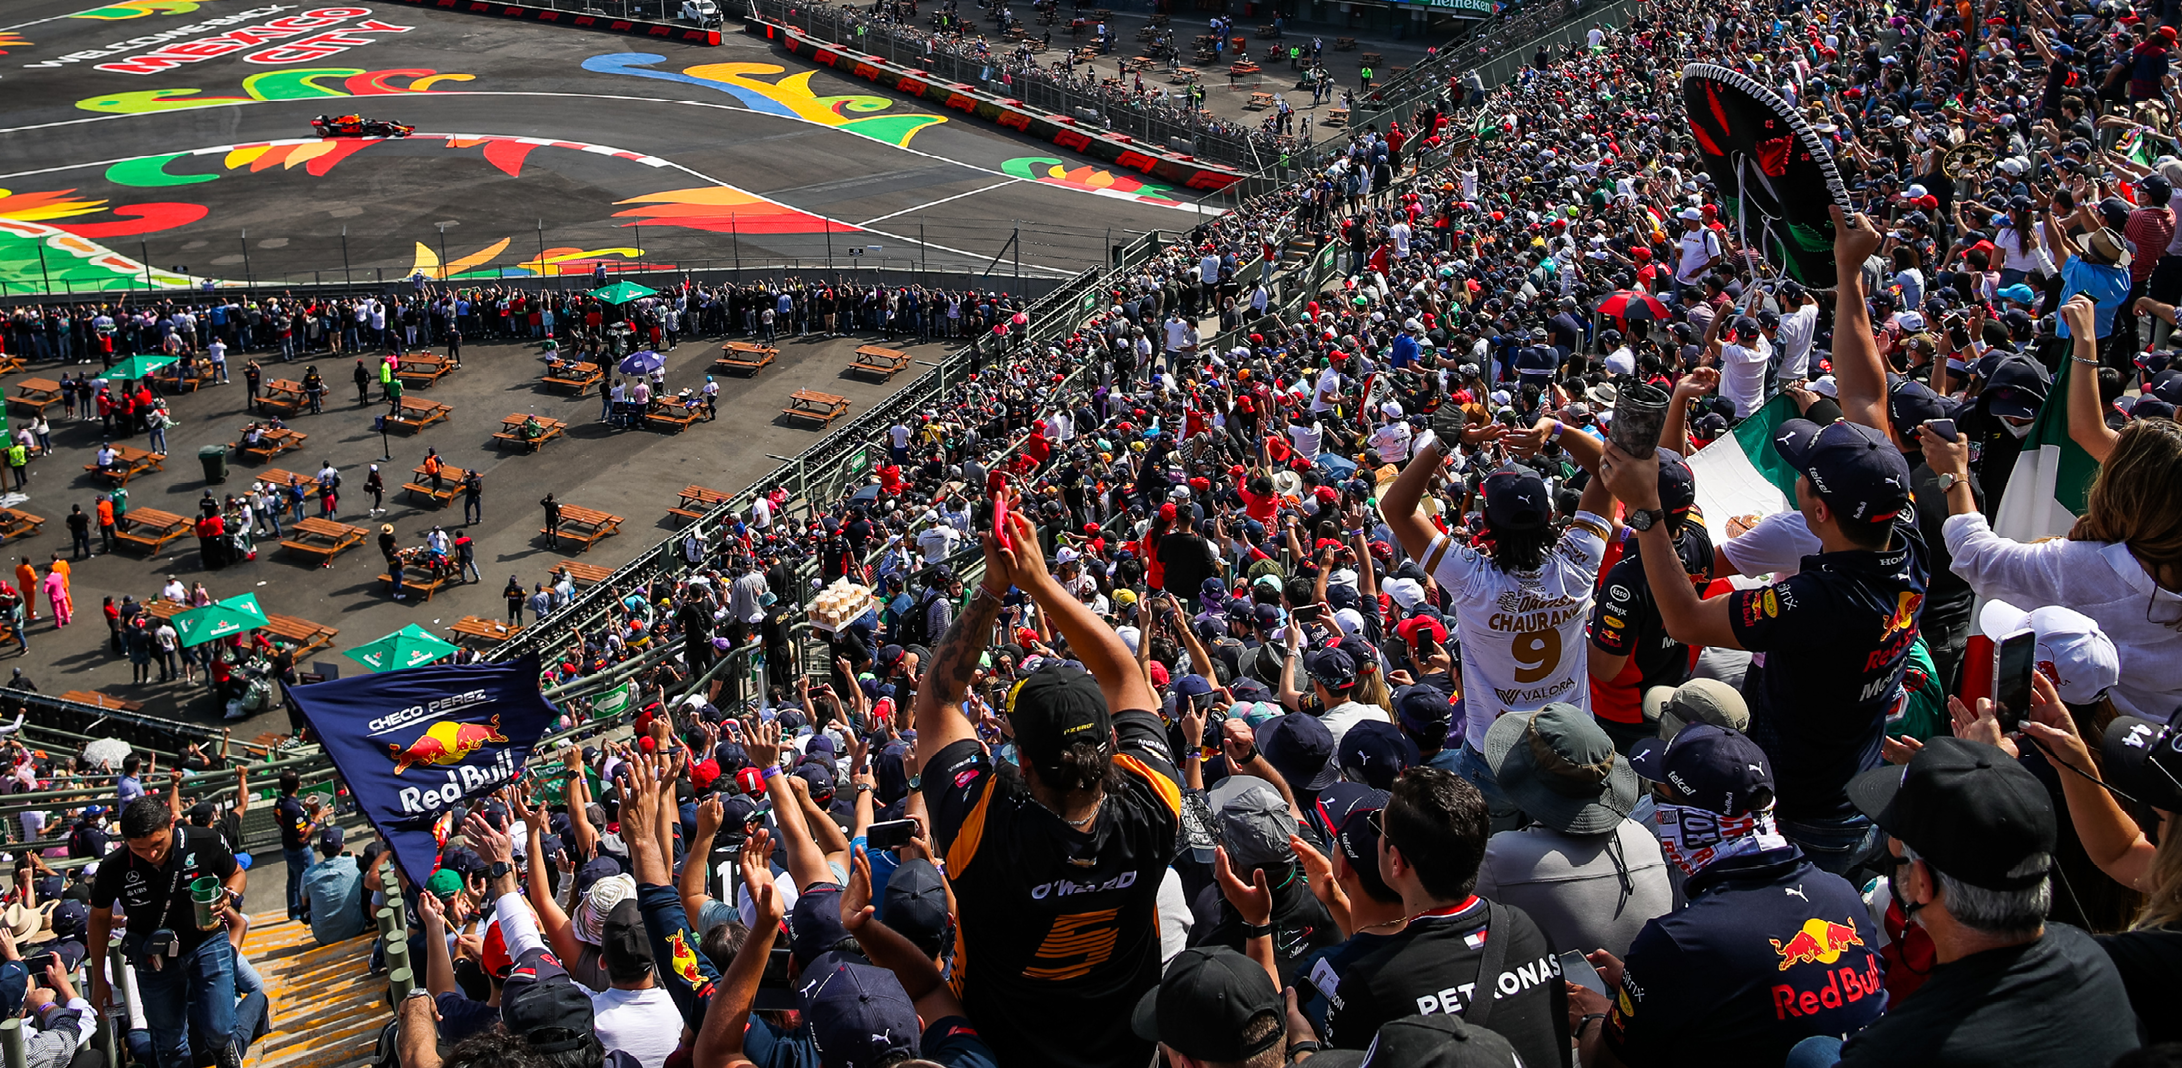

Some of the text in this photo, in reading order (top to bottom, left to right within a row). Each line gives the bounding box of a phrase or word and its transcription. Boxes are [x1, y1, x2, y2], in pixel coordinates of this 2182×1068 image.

[24, 4, 299, 68] WELCOME BACK
[93, 7, 373, 75] MEXICO
[242, 18, 415, 65] CITY
[1808, 466, 1832, 494] telcel
[1511, 627, 1562, 684] 9
[368, 689, 487, 732] CHECO PEREZ
[1522, 677, 1575, 701] VALORA
[2121, 723, 2153, 748] 44
[399, 748, 514, 816] Red Bull
[1667, 770, 1697, 796] telcel
[1341, 831, 1360, 859] telcel
[1021, 905, 1122, 981] 5
[1416, 953, 1561, 1016] PETONAS
[1771, 953, 1880, 1020] Red Bull
